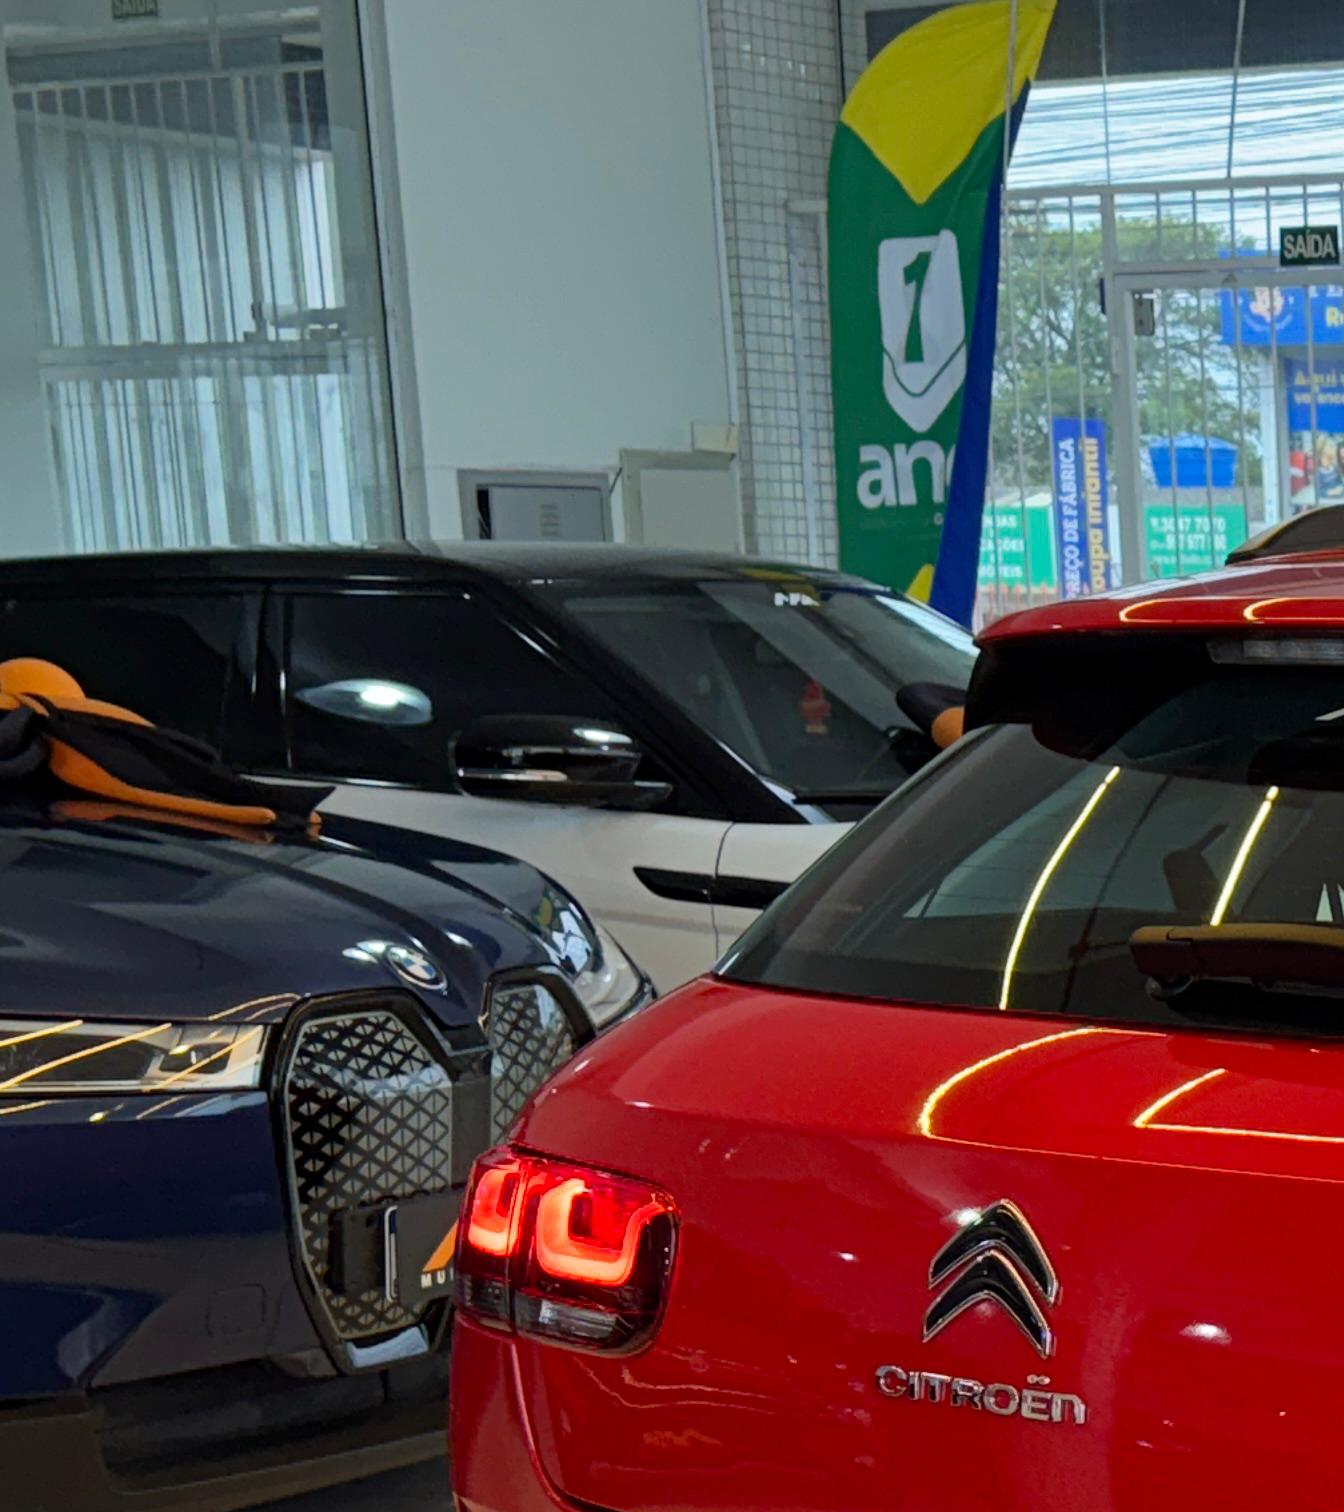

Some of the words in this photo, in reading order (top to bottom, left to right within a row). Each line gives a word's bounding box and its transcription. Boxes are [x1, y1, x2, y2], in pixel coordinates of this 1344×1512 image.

[1283, 229, 1336, 259] SAÍDA
[856, 440, 956, 510] an
[1058, 438, 1078, 516] FÁBRICA
[1063, 517, 1079, 543] DE
[1086, 528, 1109, 592] oupa
